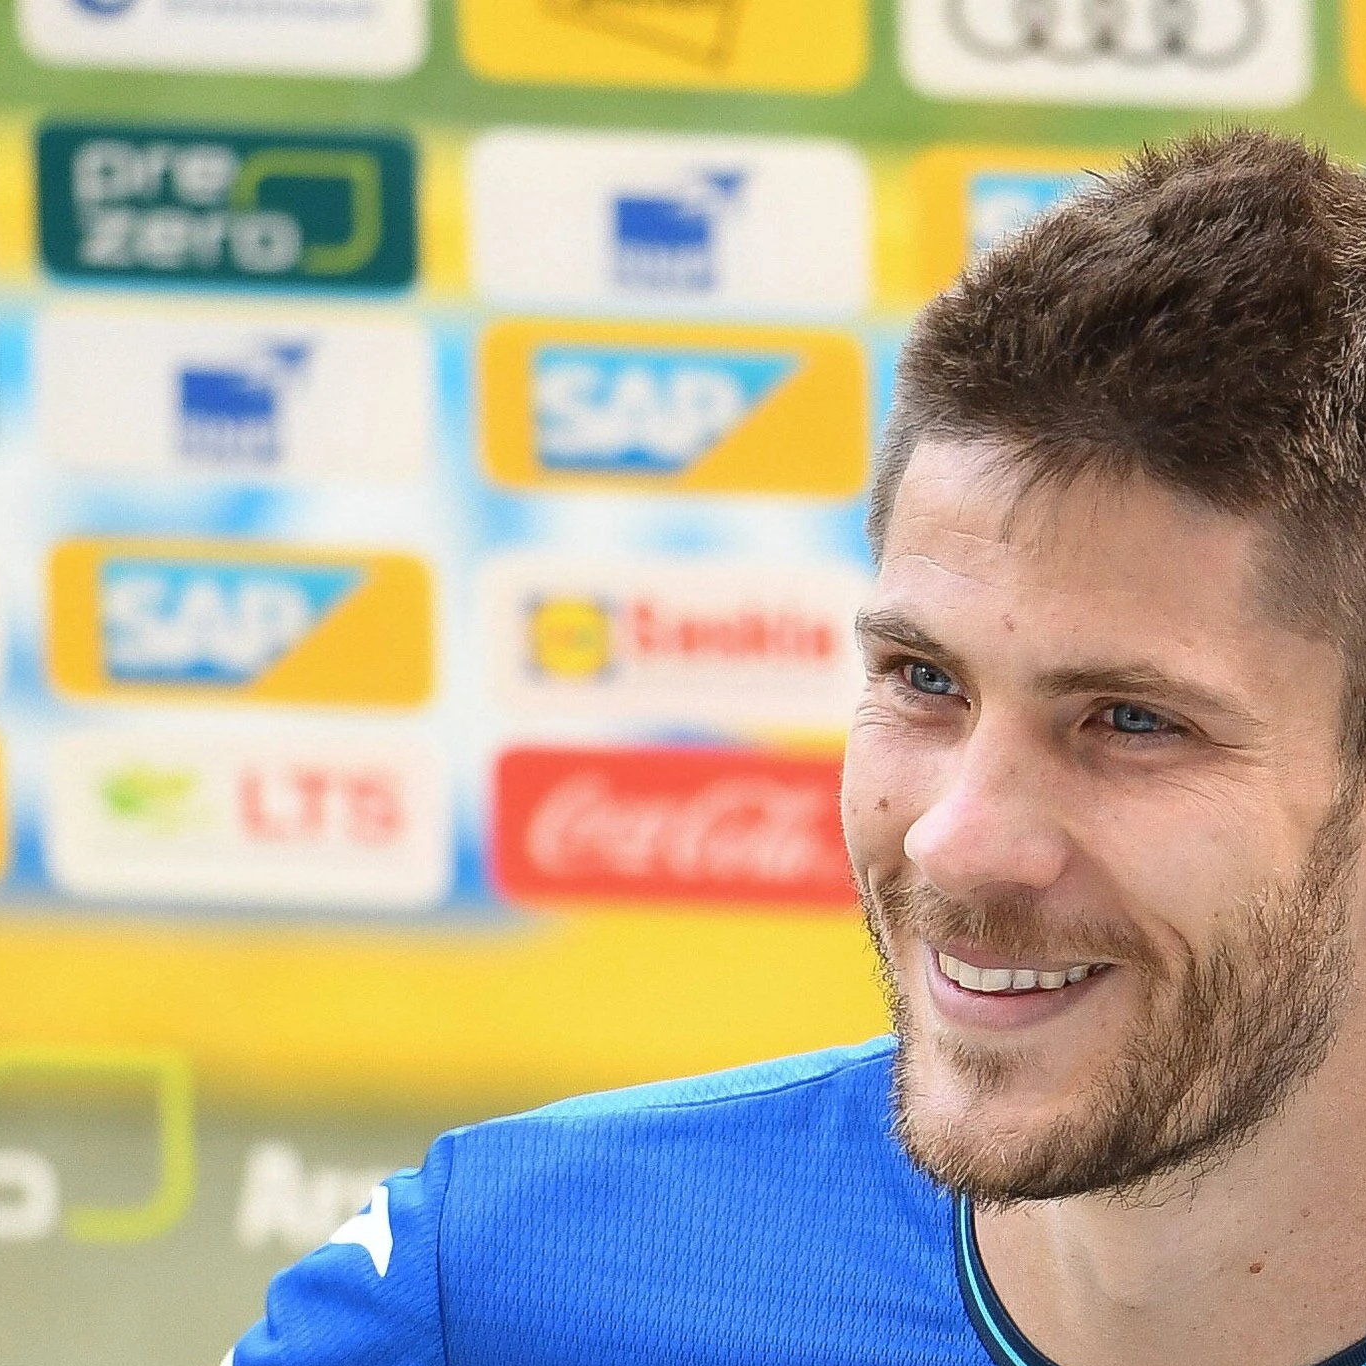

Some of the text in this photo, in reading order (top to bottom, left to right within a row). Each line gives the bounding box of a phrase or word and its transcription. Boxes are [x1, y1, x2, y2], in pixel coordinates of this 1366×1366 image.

[71, 140, 235, 212] pre
[79, 206, 303, 274] zero
[535, 357, 747, 462] SAP
[106, 574, 310, 668] SAP
